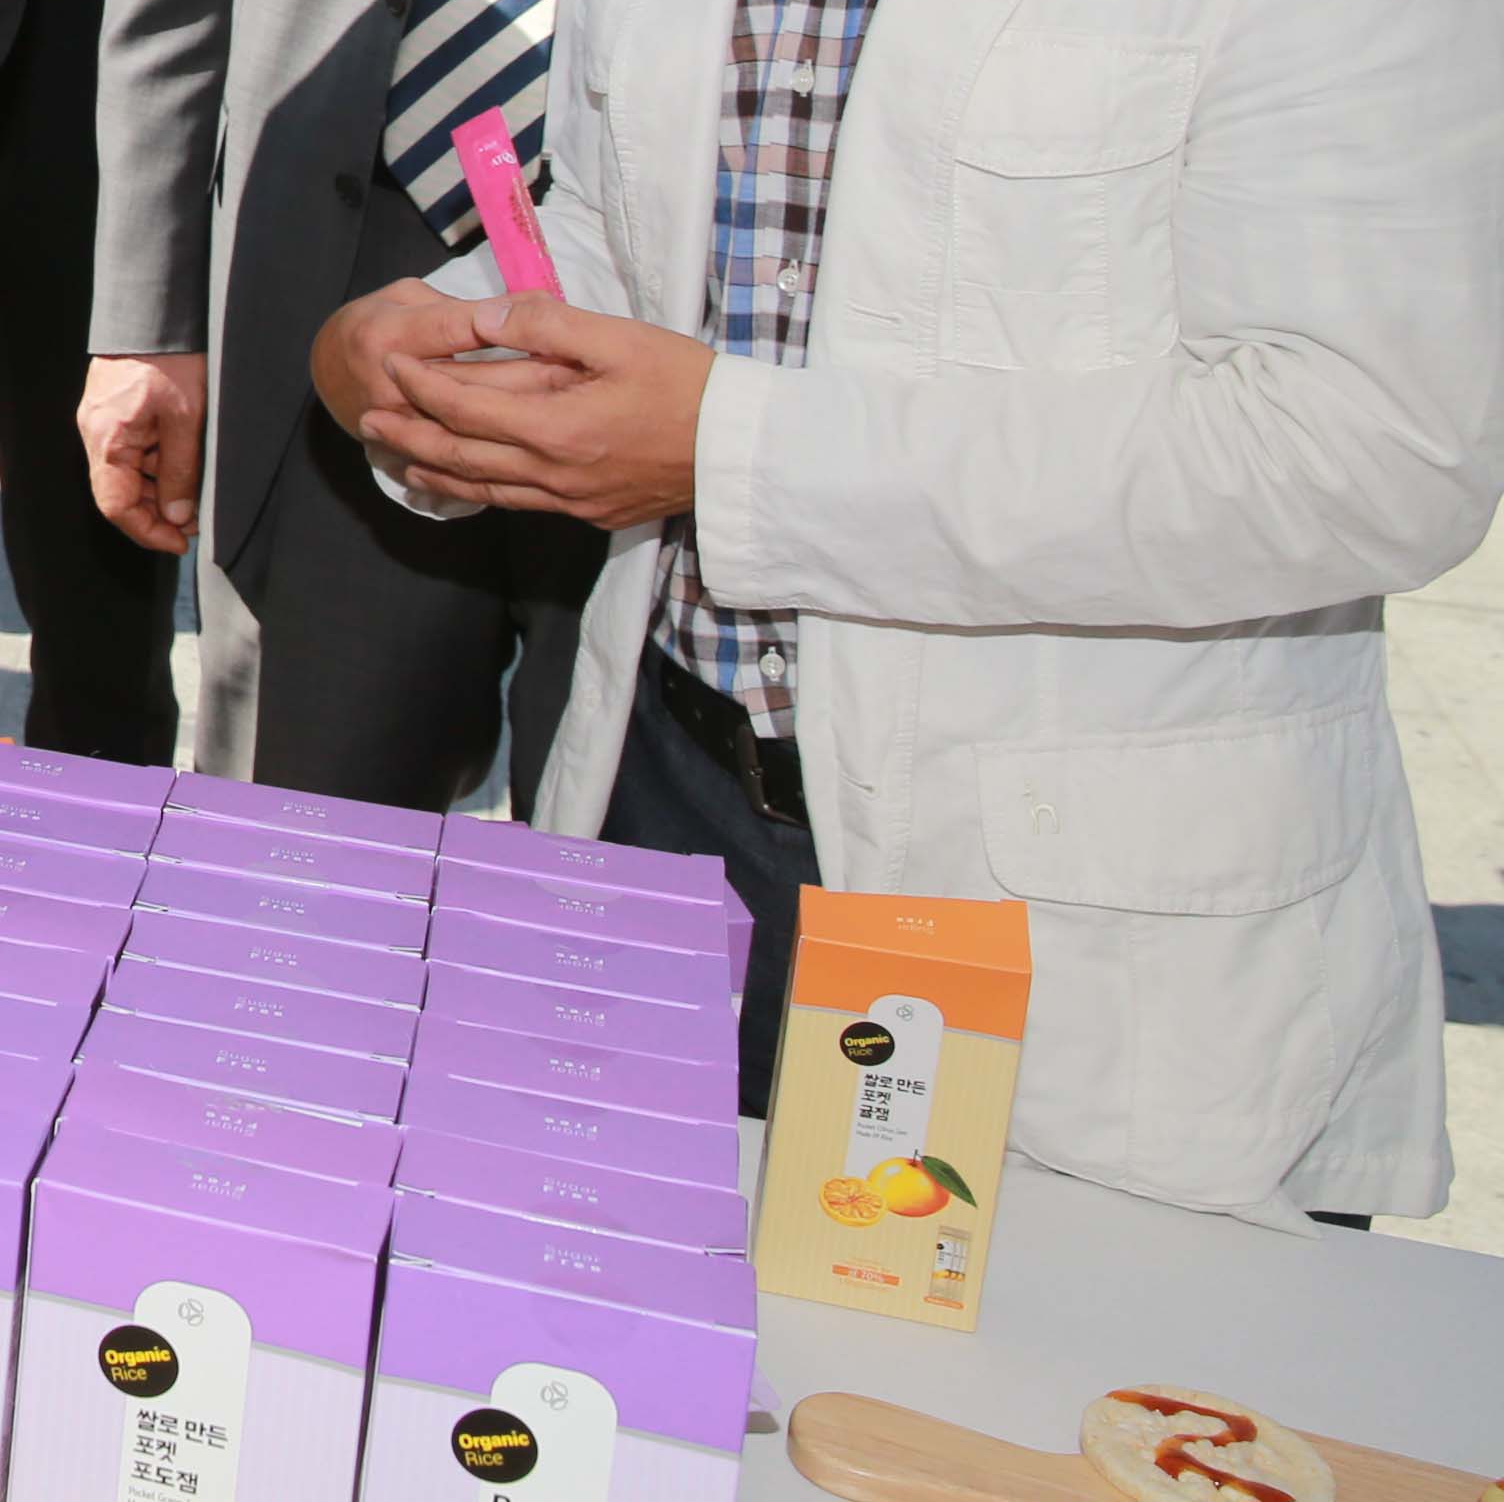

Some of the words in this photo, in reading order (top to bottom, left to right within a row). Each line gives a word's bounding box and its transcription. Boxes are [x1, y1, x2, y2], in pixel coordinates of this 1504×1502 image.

[844, 1035, 890, 1048] Organic
[848, 1047, 873, 1057] Rice
[864, 1073, 894, 1090] 쌀로
[897, 1078, 927, 1096] 만든
[860, 1088, 892, 1105] 포켓
[859, 1104, 890, 1122] 귤잼
[105, 1347, 172, 1368] Organic
[111, 1366, 147, 1382] Rice
[137, 1407, 179, 1436] 쌀로
[185, 1419, 229, 1450] 만든
[133, 1434, 177, 1464] 포켓
[458, 1430, 530, 1452] Organic
[464, 1450, 505, 1466] Rice
[131, 1460, 199, 1495] 포도잼
